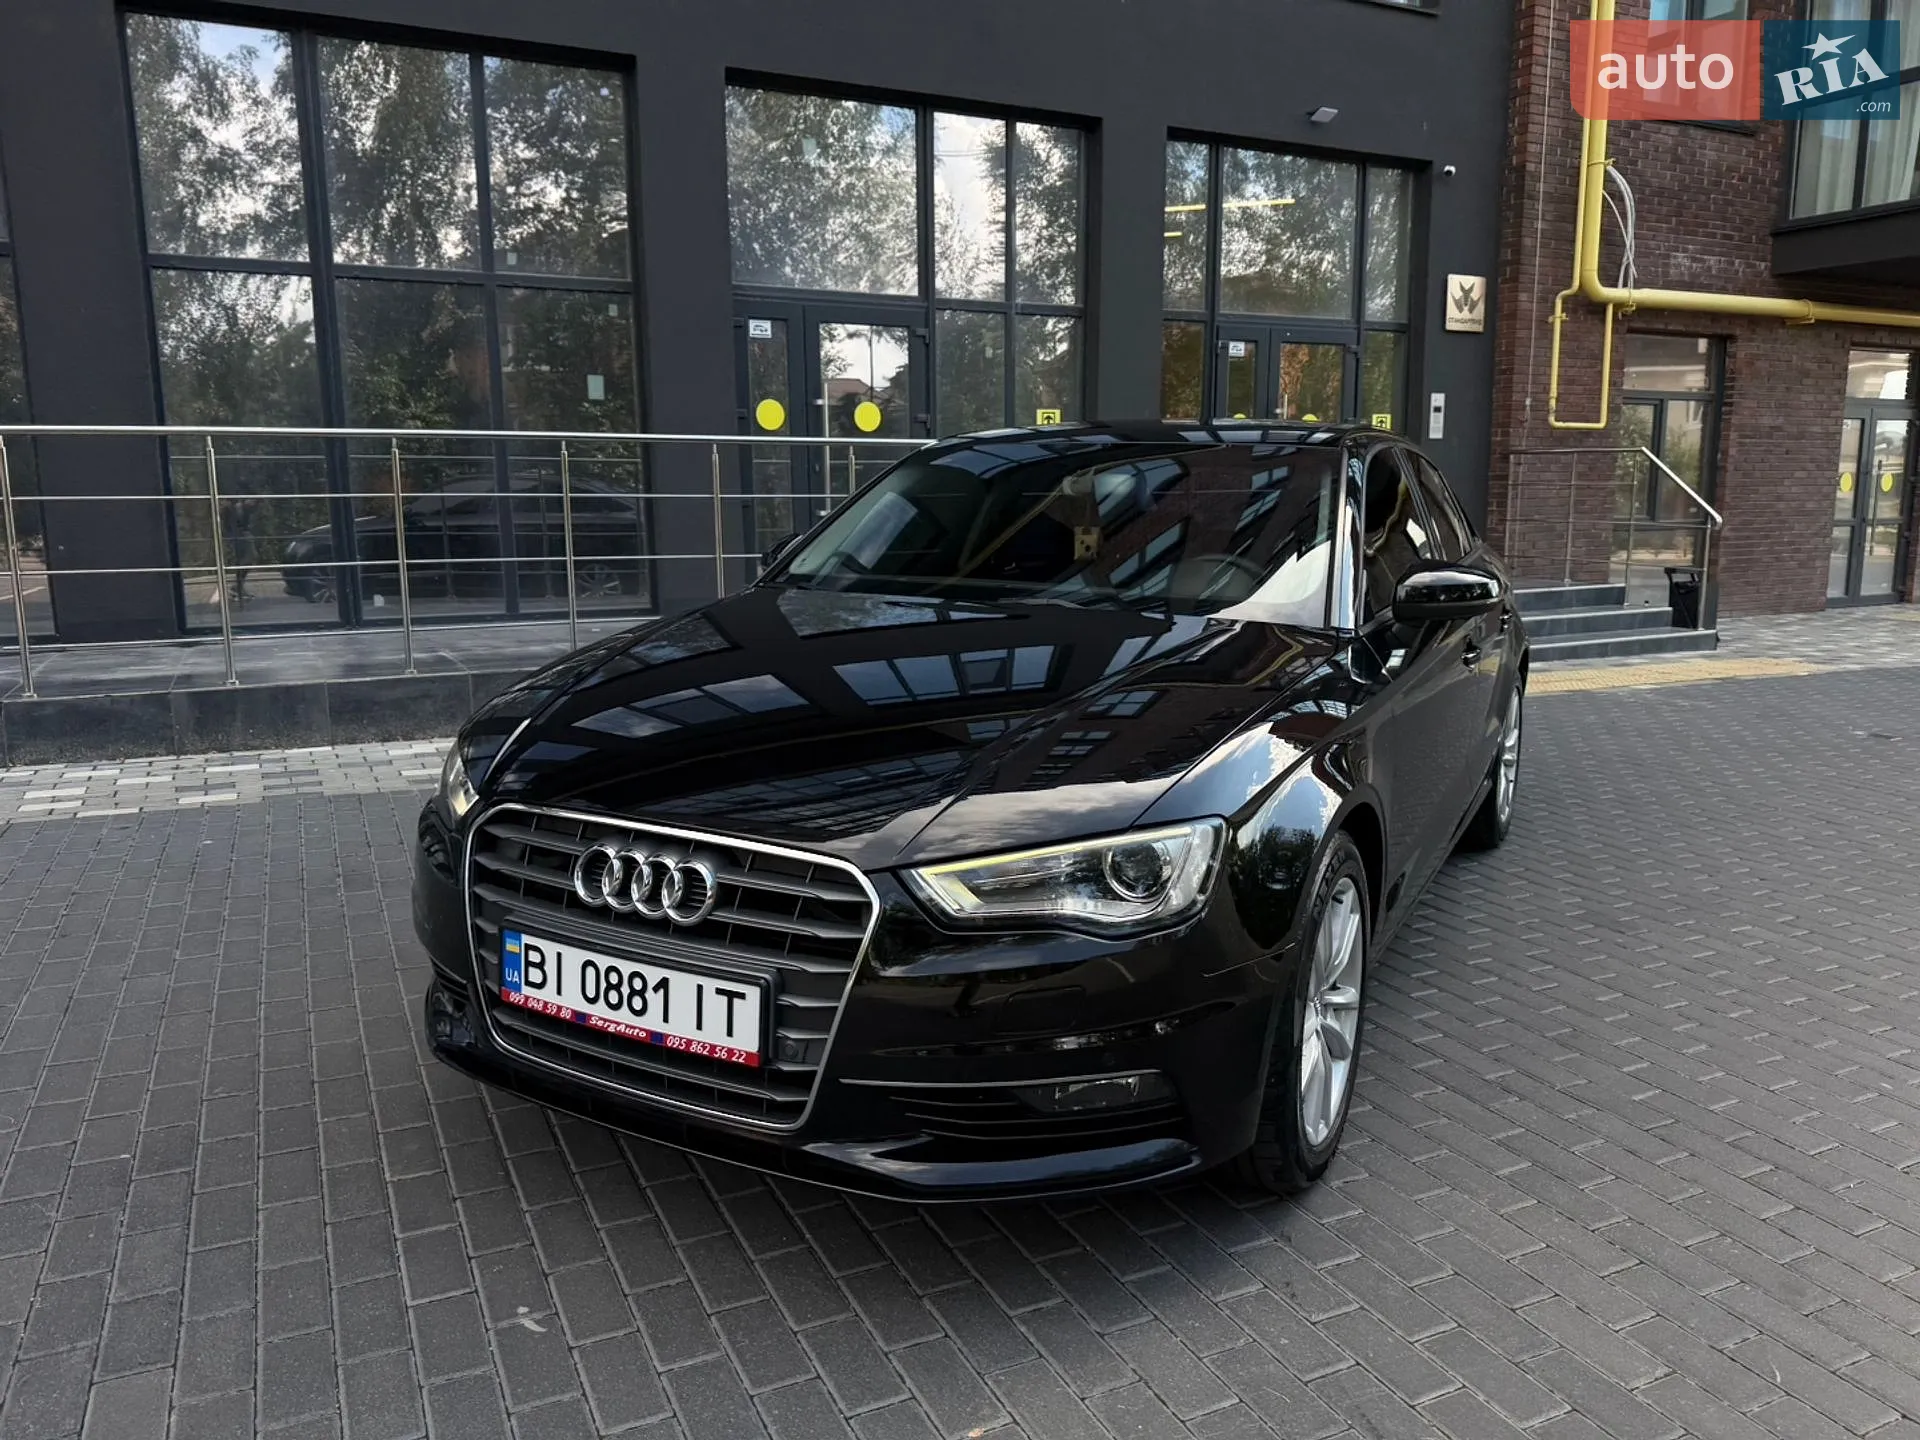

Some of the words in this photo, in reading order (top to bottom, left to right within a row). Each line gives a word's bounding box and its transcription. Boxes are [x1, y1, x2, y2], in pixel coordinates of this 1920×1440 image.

[505, 969, 520, 984] UA
[524, 942, 562, 996] BI
[581, 959, 670, 1024] 0881
[696, 983, 746, 1038] IT
[545, 1003, 558, 1015] 59
[560, 1007, 572, 1019] 80
[589, 1016, 647, 1037] SergAuto
[666, 1036, 687, 1050] 095
[690, 1041, 711, 1055] 862
[713, 1046, 728, 1059] 56
[731, 1050, 747, 1063] 22
